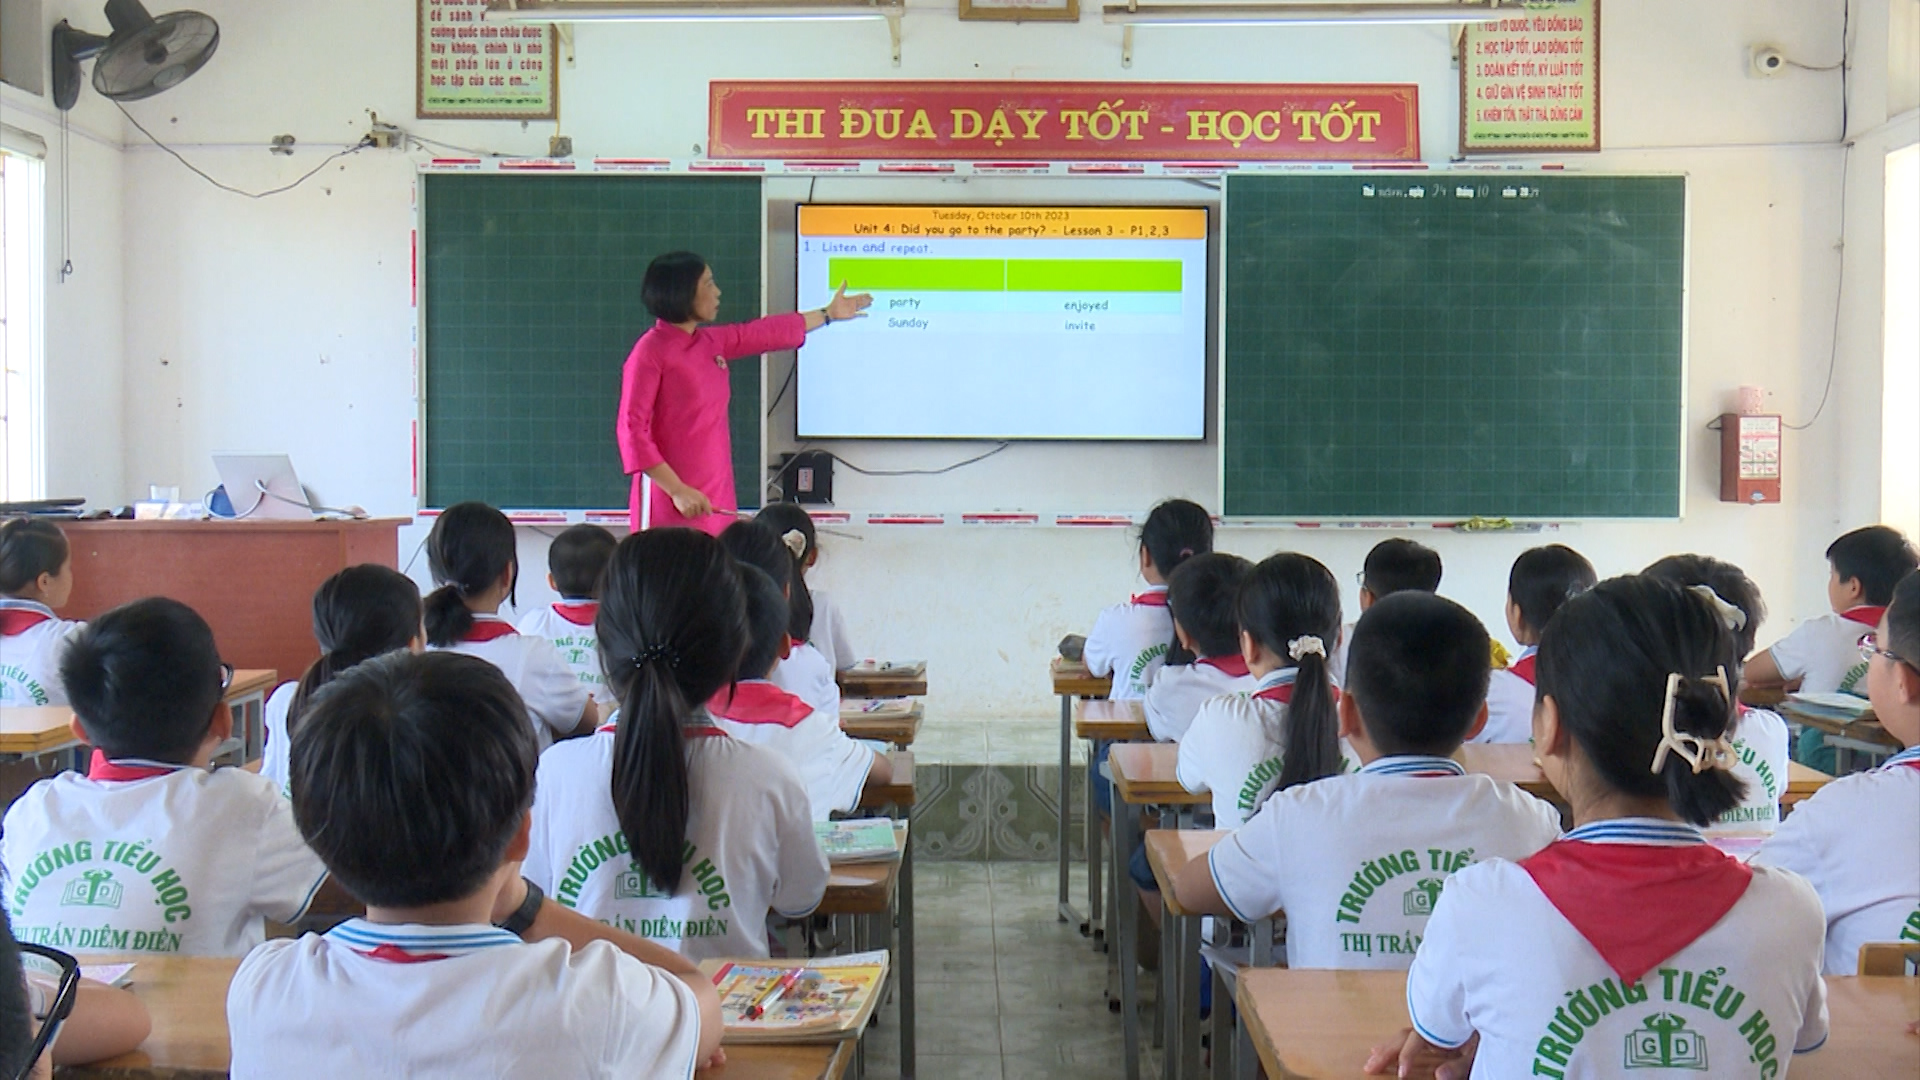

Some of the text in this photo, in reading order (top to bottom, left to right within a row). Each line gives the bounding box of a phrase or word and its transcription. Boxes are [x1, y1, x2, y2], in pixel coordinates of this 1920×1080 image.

[1570, 36, 1584, 54] TỐT
[1570, 59, 1584, 76] TỐT
[1528, 84, 1546, 99] SINH
[1569, 82, 1584, 99] TỐT
[746, 107, 826, 139] THI
[840, 107, 937, 140] ĐUA
[949, 106, 1048, 147] DẠY
[1060, 99, 1149, 141] TỐT
[1186, 109, 1281, 148] HỌC
[1291, 100, 1381, 143] TỐT
[1477, 184, 1490, 198] 10
[932, 210, 1070, 221] Tuesday, October 10th 2023
[854, 224, 878, 235] Unit
[883, 224, 896, 235] 4:
[901, 224, 920, 235] Did
[925, 227, 945, 237] you
[949, 228, 962, 238] go
[967, 226, 979, 235] to
[984, 225, 1003, 236] the
[1008, 225, 1047, 238] party?
[1063, 226, 1101, 236] Lesson
[1106, 226, 1113, 236] 3
[803, 241, 934, 255] 1. Listen and repeat.
[889, 297, 921, 310] party
[1064, 300, 1110, 313] enjoyed
[888, 317, 929, 329] Sunday
[1065, 320, 1096, 331] invite
[1755, 759, 1777, 799] HỌC
[103, 838, 162, 875] TIỂU
[151, 867, 192, 924] HỌC
[691, 857, 732, 911] HỌC
[1336, 849, 1420, 925] TRƯỜNG
[640, 914, 682, 939] DIÊM
[686, 914, 729, 938] ĐIỀN
[78, 924, 129, 950] DIÊM
[131, 925, 183, 953] ĐIỀN
[1340, 933, 1372, 957] THỊ
[1532, 966, 1779, 1080] TRƯỜNG TIỂU HỌC
